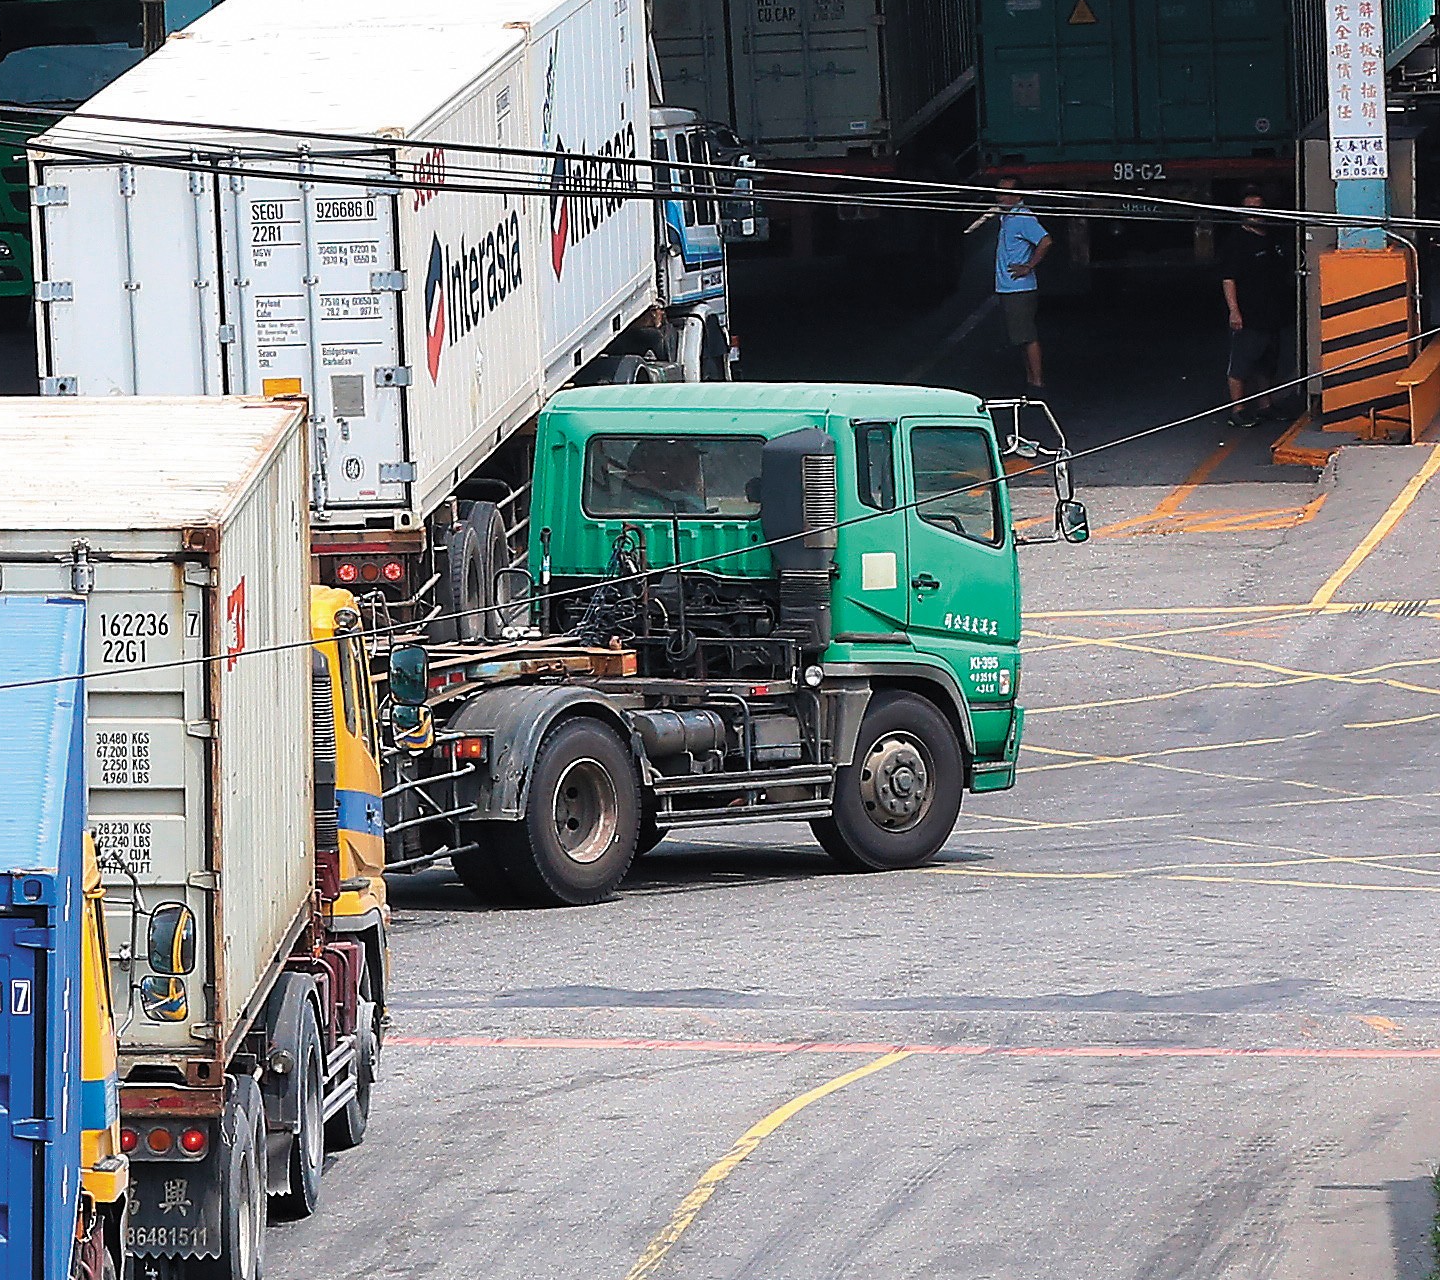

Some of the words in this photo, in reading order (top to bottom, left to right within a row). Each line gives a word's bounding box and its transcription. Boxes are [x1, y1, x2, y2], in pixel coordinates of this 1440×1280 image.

[567, 121, 639, 246] Interasia
[252, 204, 283, 220] SEGU
[317, 202, 362, 218] 926686
[367, 200, 373, 217] 0
[253, 226, 282, 242] 22R1
[445, 210, 523, 348] Interasia
[99, 614, 169, 637] 162236
[186, 612, 200, 637] 7
[103, 641, 147, 663] 22G1
[96, 733, 127, 744] 30.480
[132, 733, 150, 744] KGS
[96, 746, 127, 757] 67.200
[132, 746, 149, 757] LBS
[103, 759, 127, 771] 2.250
[133, 759, 150, 770] KGS
[103, 773, 128, 784] 4.960
[133, 773, 149, 783] LBS
[98, 823, 129, 835] 28.230
[134, 823, 151, 834] KGS
[98, 836, 129, 848] 62.240
[134, 836, 151, 847] LBS
[12, 980, 30, 1014] 7
